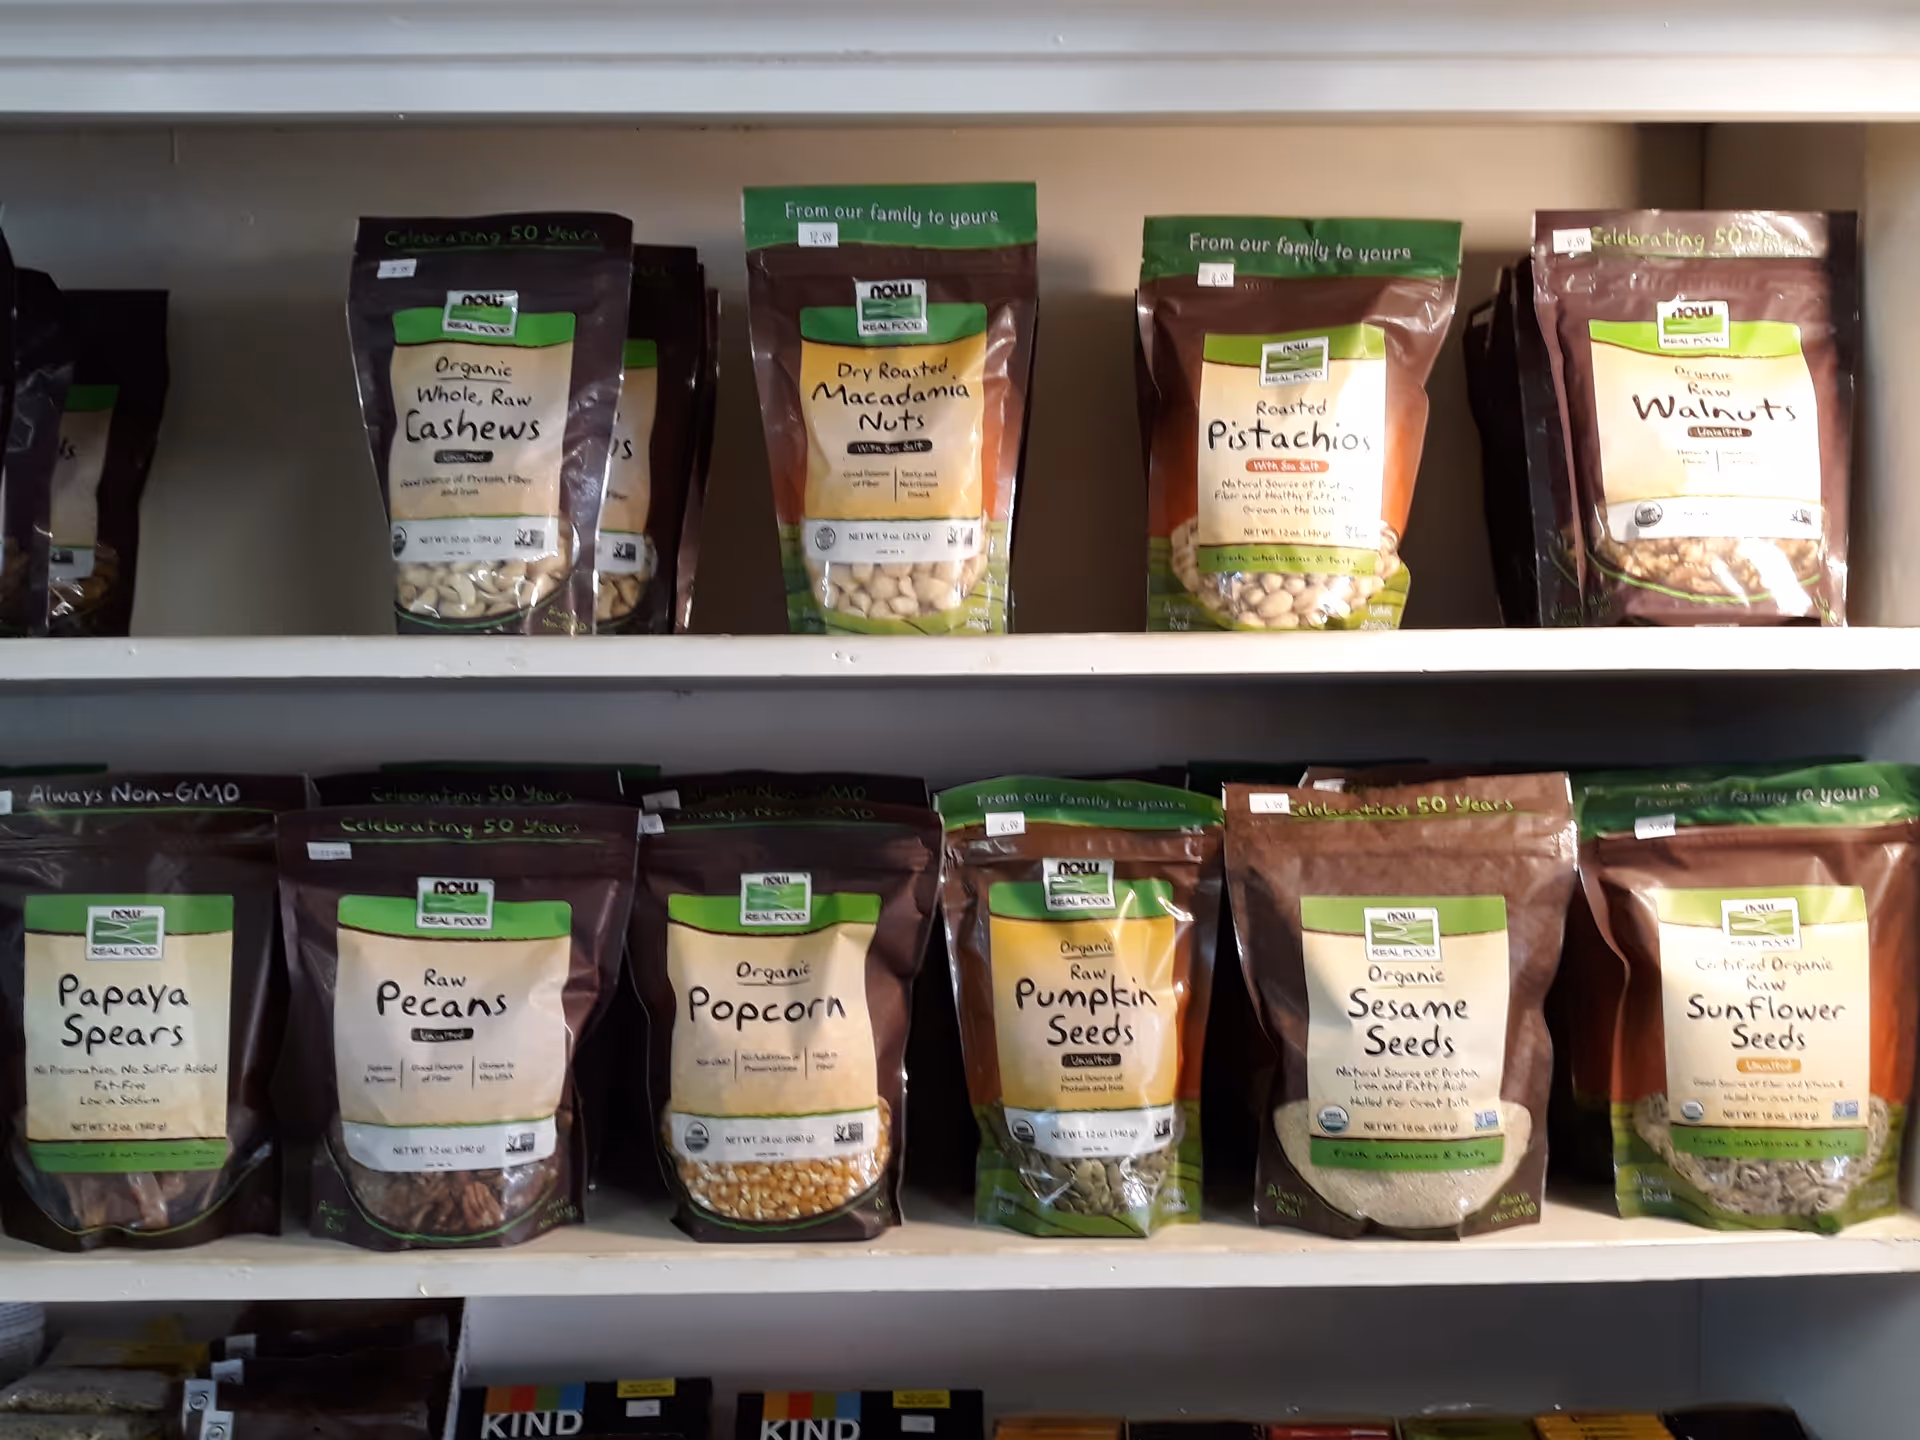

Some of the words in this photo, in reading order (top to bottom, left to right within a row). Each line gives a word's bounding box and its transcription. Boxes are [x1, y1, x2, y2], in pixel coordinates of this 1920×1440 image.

[785, 202, 829, 220] From
[835, 206, 863, 220] our
[870, 203, 922, 228] family
[929, 209, 945, 225] to
[951, 211, 1000, 230] yours
[384, 229, 501, 247] Celebrating
[511, 224, 539, 241] 50
[1590, 226, 1706, 250] Celebrating
[1714, 227, 1741, 246] 50
[1189, 232, 1234, 251] From
[1240, 237, 1271, 252] our
[1277, 236, 1329, 260] family
[1336, 243, 1353, 259] to
[1359, 247, 1411, 262] yours
[862, 321, 890, 332] REAL
[892, 320, 923, 332] FOOD
[435, 356, 513, 378] Organic
[838, 362, 873, 383] Dry
[879, 357, 949, 380] Roasted
[417, 386, 483, 406] Whole,
[490, 390, 532, 407] Raw
[811, 375, 970, 406] Macadamia
[1688, 382, 1731, 398] Raw
[1256, 399, 1327, 417] Roasted
[1632, 394, 1797, 422] Walnuts
[406, 409, 542, 444] Cashews
[859, 411, 925, 433] Nuts
[1207, 418, 1371, 452] Pistachios
[1253, 460, 1280, 472] With
[1300, 460, 1321, 472] Salt
[1221, 478, 1263, 490] Natural
[1293, 505, 1310, 515] the
[29, 783, 101, 805] Always
[111, 781, 241, 804] Non-GMO
[488, 784, 515, 801] 50
[976, 793, 1019, 808] From
[1024, 793, 1053, 803] our
[1060, 792, 1110, 810] family
[1117, 799, 1133, 809] to
[1796, 788, 1814, 801] to
[1820, 785, 1880, 807] yours
[1288, 799, 1409, 818] Celebrating
[1416, 795, 1447, 814] 50
[1456, 794, 1514, 813] Years
[340, 818, 473, 839] Celebrating
[483, 818, 514, 834] 50
[523, 818, 581, 835] Years
[421, 915, 451, 926] REAL
[453, 915, 488, 926] FOOD
[91, 946, 121, 956] REAL
[123, 946, 159, 956] FOOD
[1060, 938, 1114, 957] Organic
[736, 961, 811, 982] Organic
[1070, 964, 1107, 980] Raw
[1367, 965, 1447, 987] Organic
[1771, 956, 1834, 976] Organic
[424, 968, 467, 988] Raw
[1746, 974, 1787, 992] Raw
[58, 973, 190, 1014] Papaya
[376, 980, 508, 1018] Pecans
[1015, 973, 1157, 1016] Pumpkin
[1348, 987, 1470, 1020] Sesame
[688, 986, 847, 1032] Popcorn
[1686, 993, 1847, 1022] Sunflower
[60, 1013, 184, 1055] Spears
[1047, 1013, 1135, 1047] Seeds
[1364, 1024, 1456, 1058] Seeds
[1731, 1022, 1808, 1051] Seeds
[121, 1064, 139, 1075] No
[1335, 1067, 1382, 1079] Natural
[1383, 1067, 1421, 1079] Source
[1353, 1080, 1381, 1091] Iron
[1382, 1080, 1403, 1091] and
[1405, 1080, 1440, 1094] Fatty
[480, 1410, 584, 1440] KIND
[760, 1418, 861, 1440] KIND
